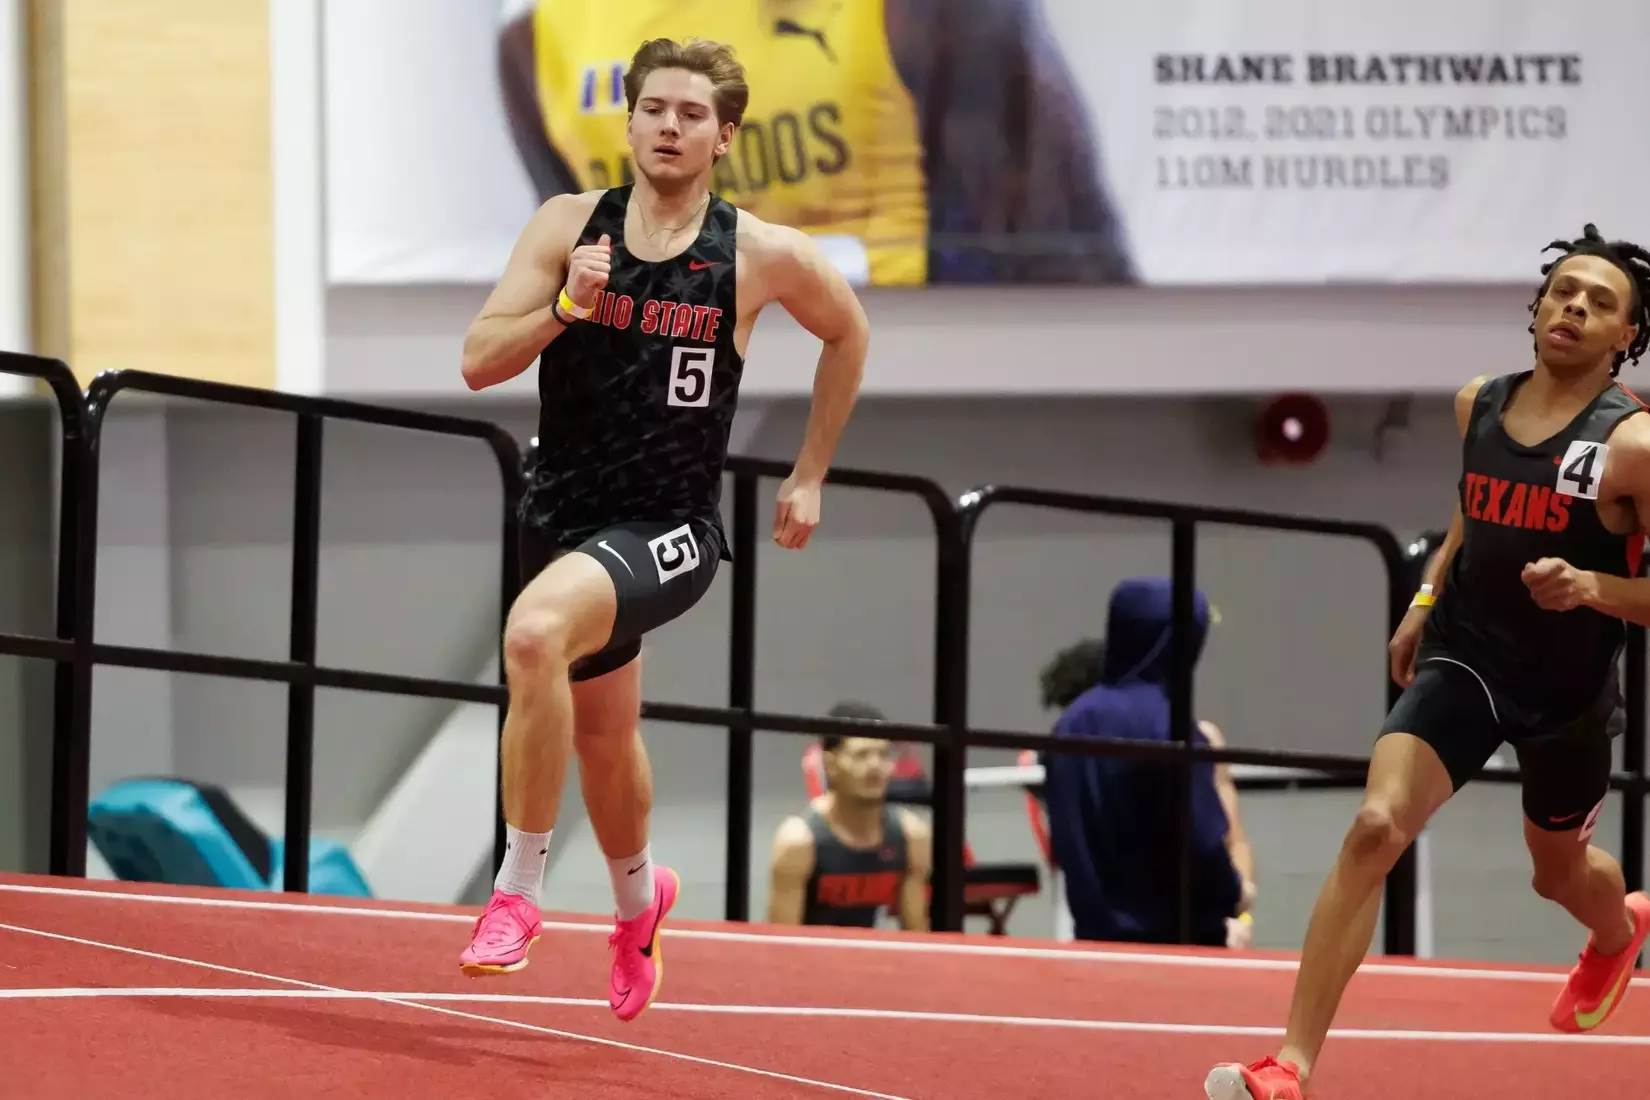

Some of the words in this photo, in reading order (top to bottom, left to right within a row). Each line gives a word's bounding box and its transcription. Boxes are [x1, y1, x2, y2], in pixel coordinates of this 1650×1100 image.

[1154, 52, 1293, 84] SHANE
[1307, 52, 1582, 84] BRATHWAITE
[1154, 106, 1259, 141] 2012,
[1264, 106, 1354, 140] 2021
[1365, 105, 1567, 140] OLYMPICS
[1156, 155, 1253, 188] 110M
[1263, 154, 1450, 189] HURDLES
[640, 299, 722, 342] STATE
[674, 351, 707, 403] 5
[1563, 445, 1598, 494] 4
[1465, 472, 1573, 532] TEXANS
[657, 533, 696, 571] 5
